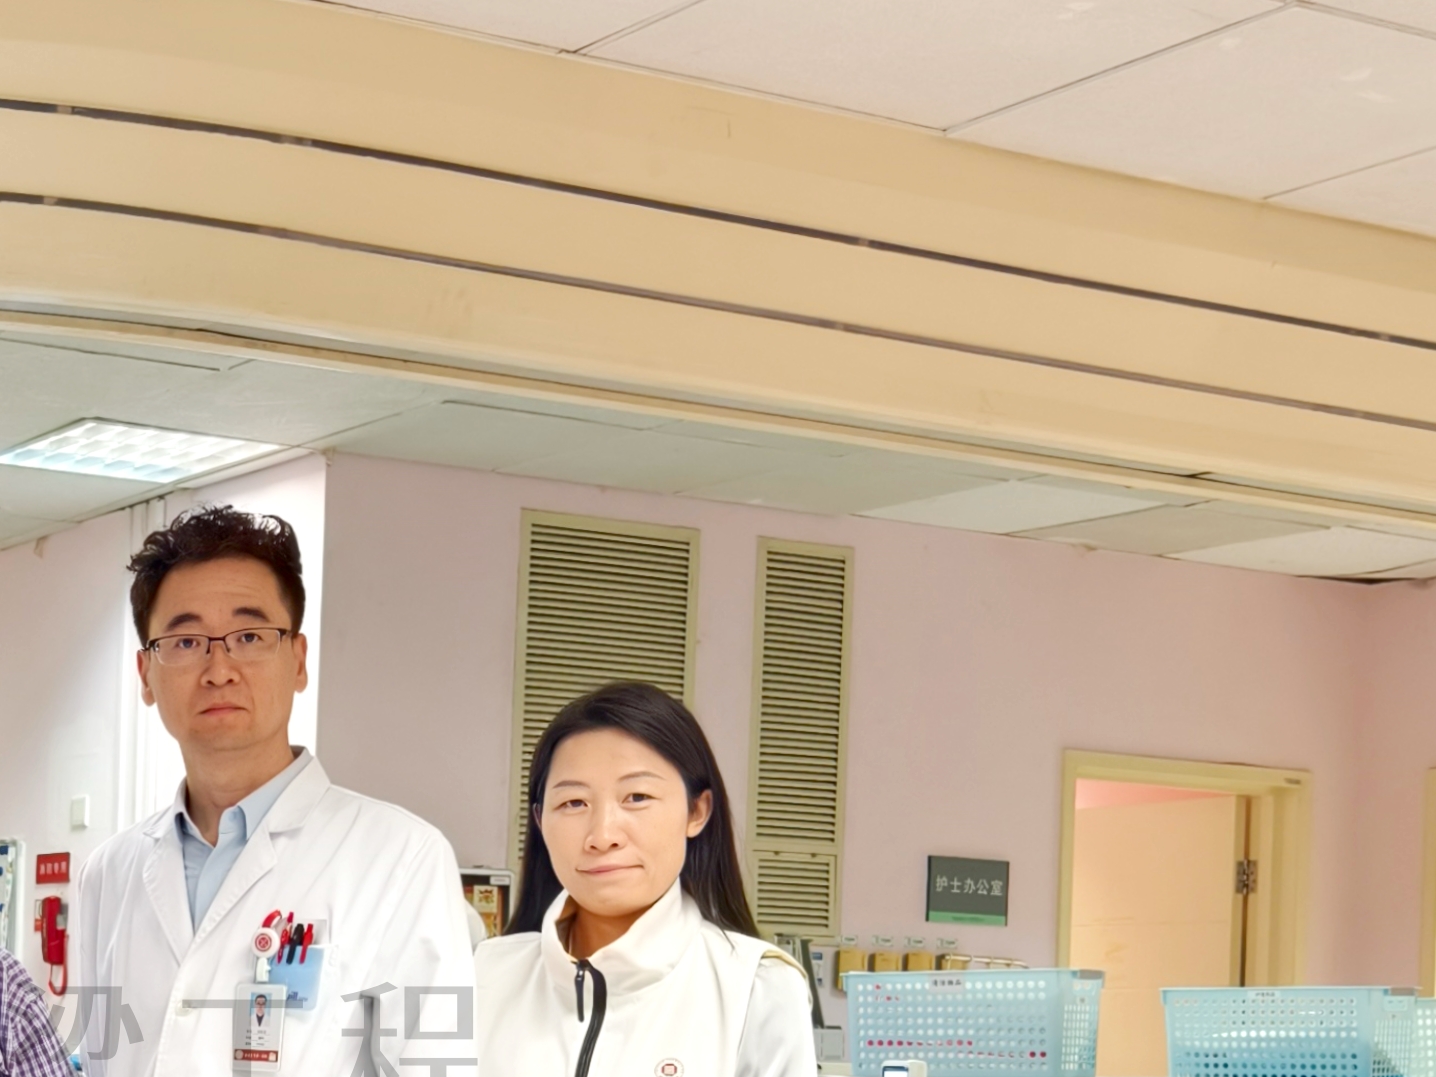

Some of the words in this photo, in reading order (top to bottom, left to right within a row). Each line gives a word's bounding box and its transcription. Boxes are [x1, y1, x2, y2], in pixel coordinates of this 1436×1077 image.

[935, 874, 1004, 896] 护士办公室
